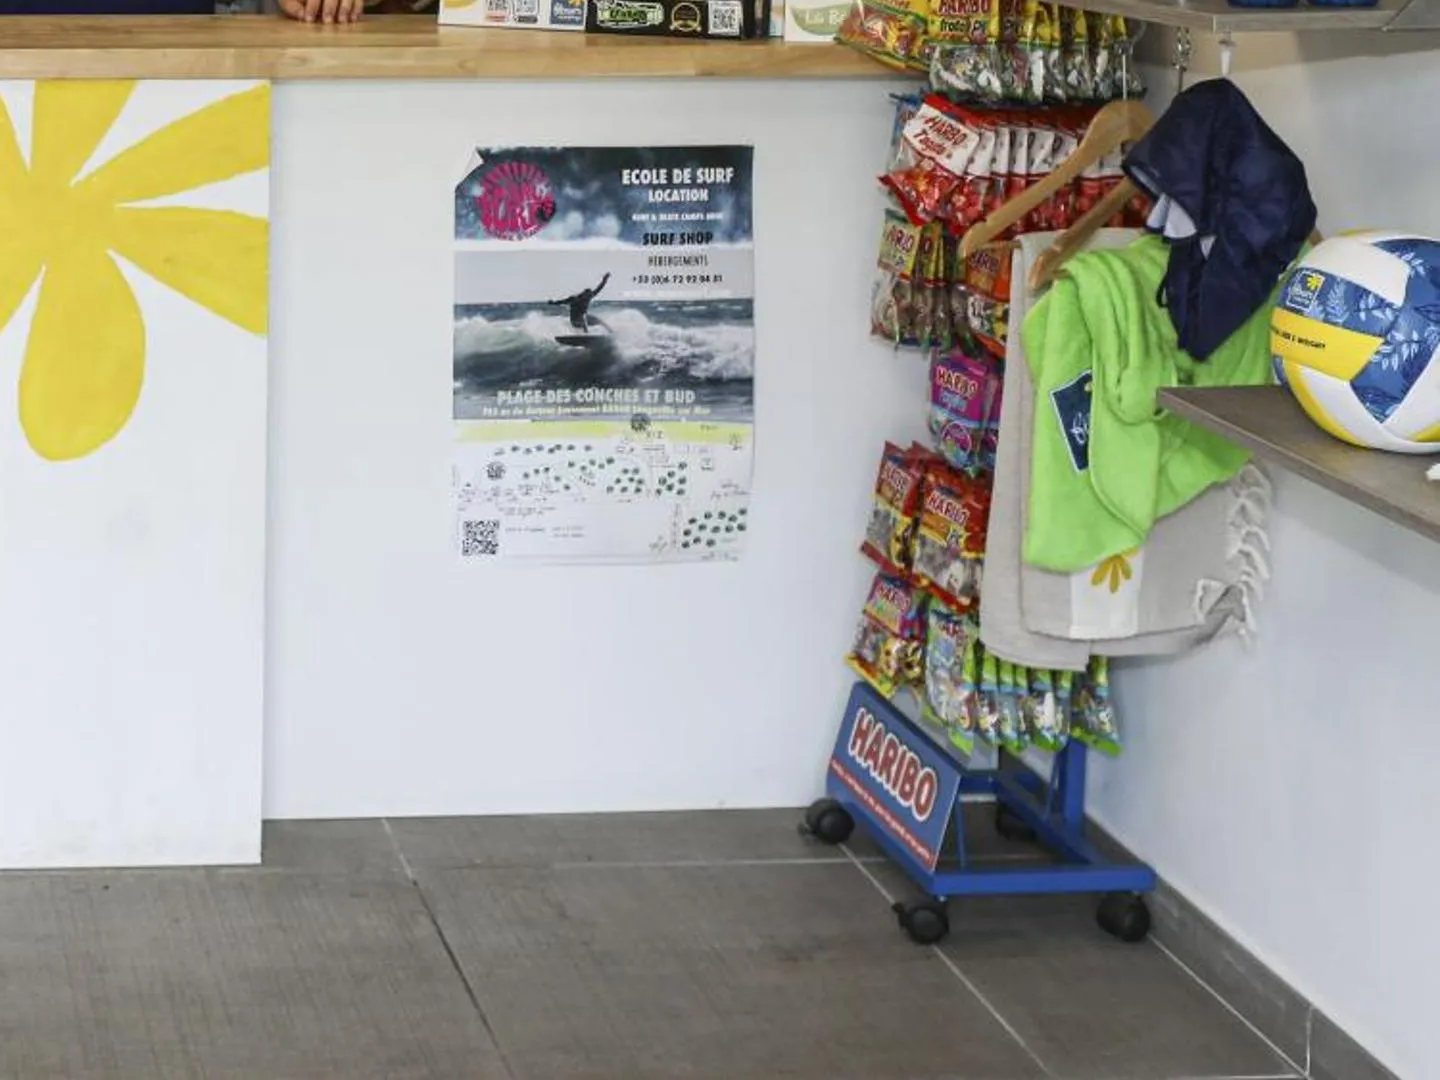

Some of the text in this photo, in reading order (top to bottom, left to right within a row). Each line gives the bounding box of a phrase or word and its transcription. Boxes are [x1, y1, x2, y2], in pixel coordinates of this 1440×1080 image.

[923, 114, 968, 146] HARIBO
[622, 166, 734, 185] ECOLE DE SURF
[648, 188, 709, 203] LOCATION
[643, 231, 714, 246] SURF SHOP
[497, 390, 542, 405] PLAGE
[575, 387, 641, 404] CONCHES
[644, 389, 660, 403] ET
[847, 707, 938, 823] HARIBO
